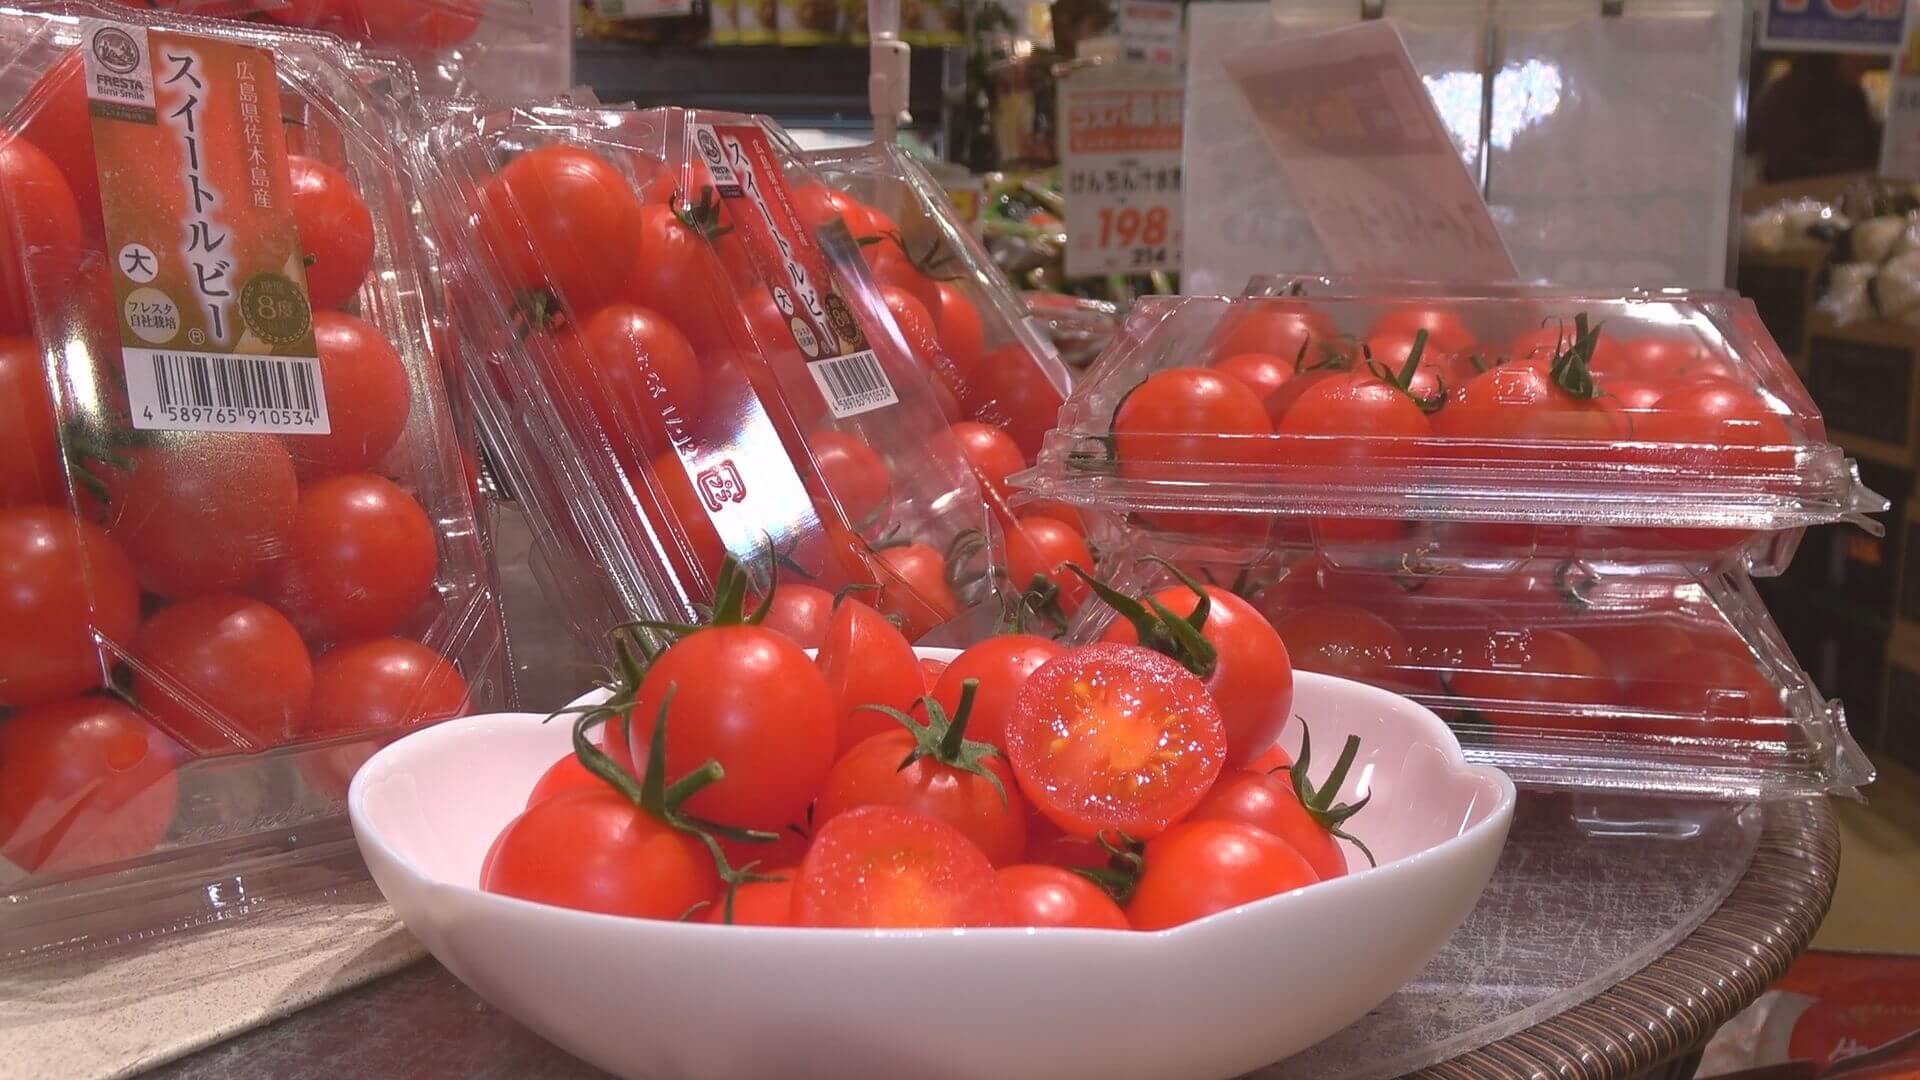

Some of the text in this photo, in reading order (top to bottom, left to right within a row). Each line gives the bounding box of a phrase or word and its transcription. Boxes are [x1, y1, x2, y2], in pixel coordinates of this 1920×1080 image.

[97, 74, 144, 91] FRESTA
[235, 61, 272, 208] 広島県佐木島産
[164, 53, 230, 338] スイートルビー
[1098, 206, 1168, 249] 198
[728, 142, 834, 347] スイートルビー
[125, 248, 153, 275] 大
[128, 301, 172, 314] フレスタ
[777, 289, 792, 310] 大
[130, 314, 176, 330] 自社栽培
[143, 405, 314, 425] 4 589765 910534
